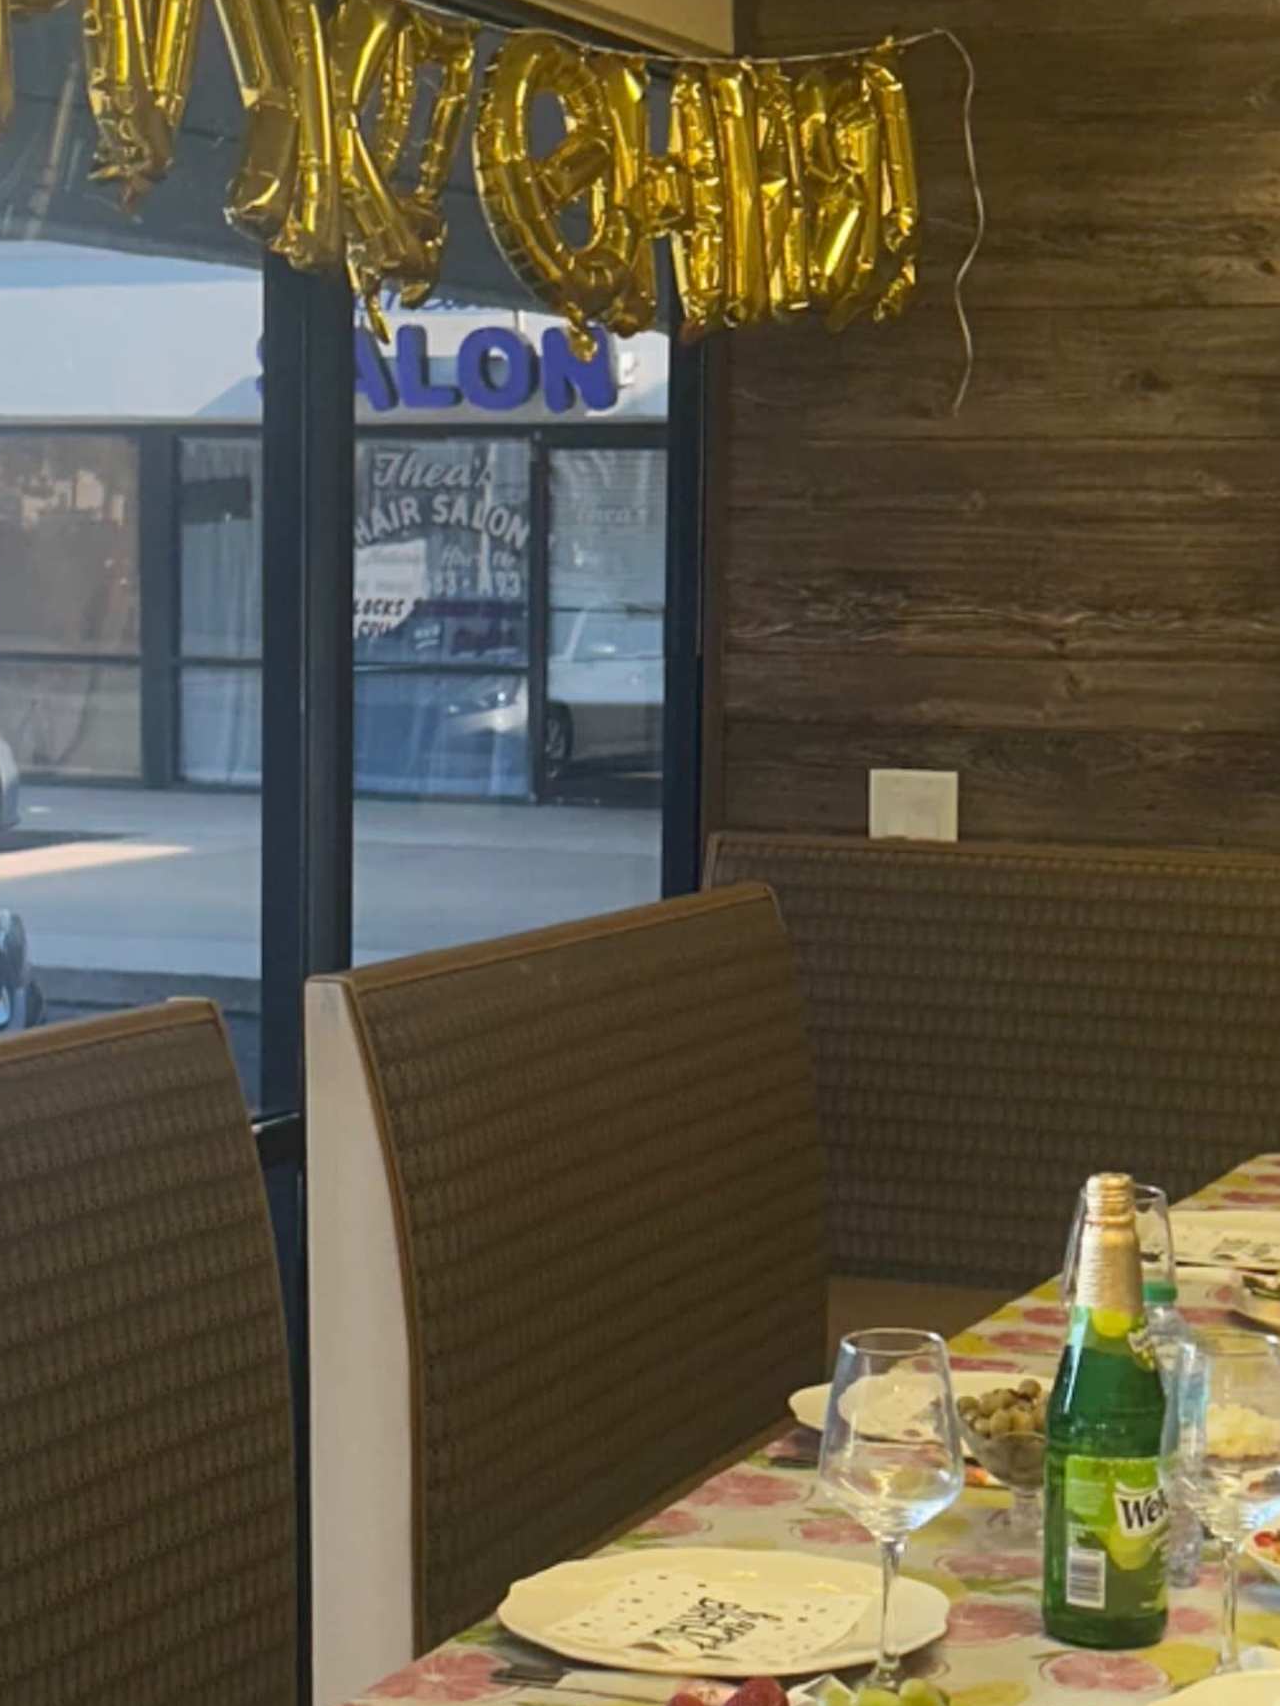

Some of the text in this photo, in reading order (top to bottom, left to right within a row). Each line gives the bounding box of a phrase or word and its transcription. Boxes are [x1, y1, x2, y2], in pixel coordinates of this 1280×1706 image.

[372, 449, 497, 489] Thea's
[353, 493, 531, 551] HAIR SALON
